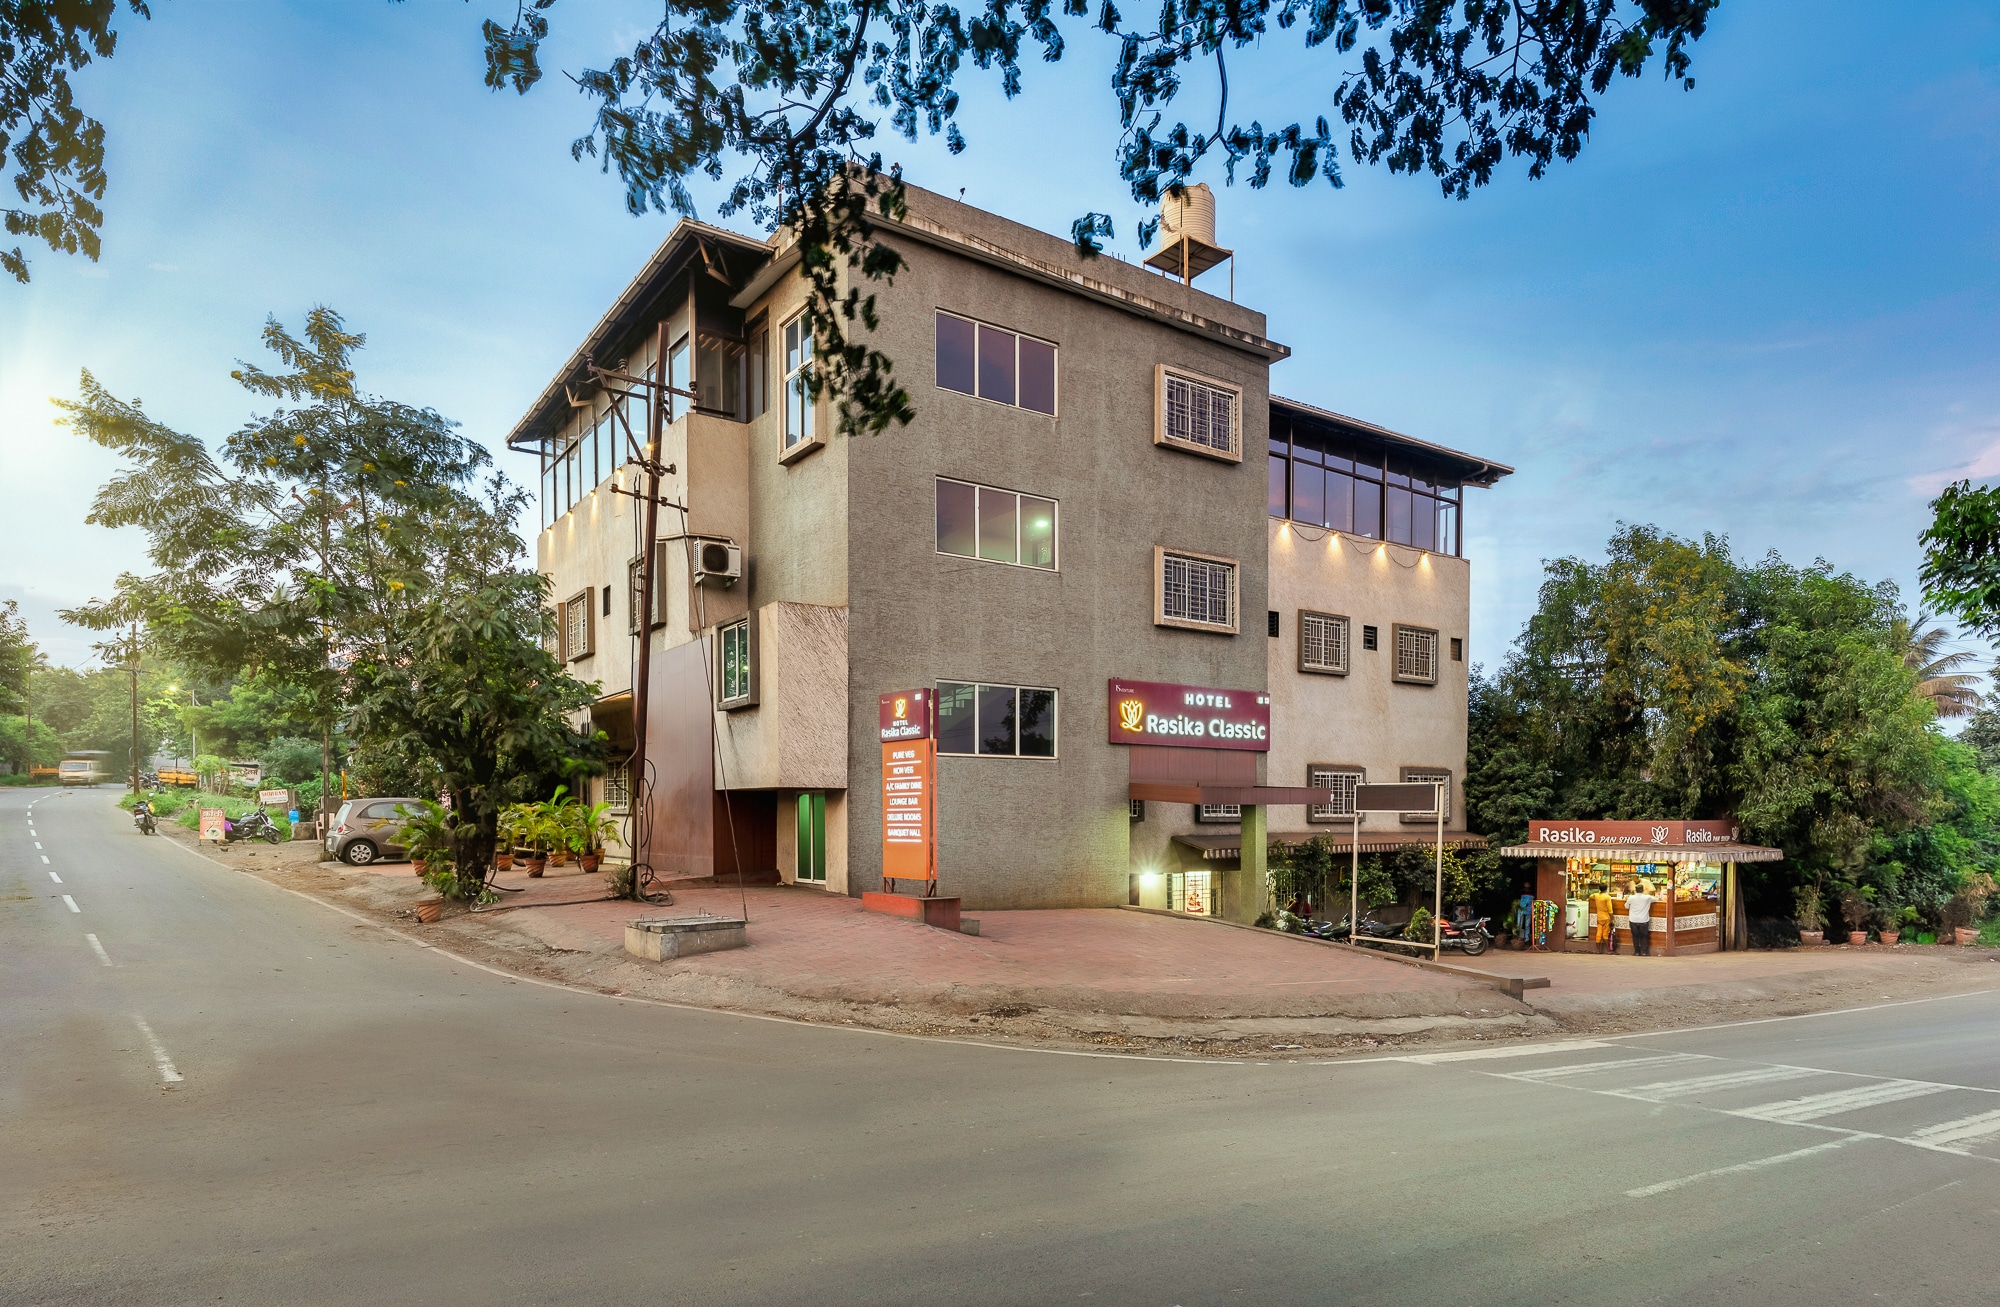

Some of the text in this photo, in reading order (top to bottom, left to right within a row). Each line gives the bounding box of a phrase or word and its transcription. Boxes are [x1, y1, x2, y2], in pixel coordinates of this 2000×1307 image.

[1184, 693, 1232, 708] HOTEL
[881, 725, 921, 738] Rasika Classic
[1147, 714, 1266, 740] Rasika Classic
[893, 750, 915, 759] PURE VEG
[893, 766, 914, 775] NON VEG
[886, 782, 895, 791] A/C
[895, 782, 911, 790] FAMILY
[889, 797, 918, 806] LOUNGE BAR
[904, 813, 921, 821] ROOMS
[887, 828, 921, 837] BANQUET HALL
[1539, 827, 1642, 844] Rasika PAN SHOP
[1685, 829, 1712, 843] Rasika
